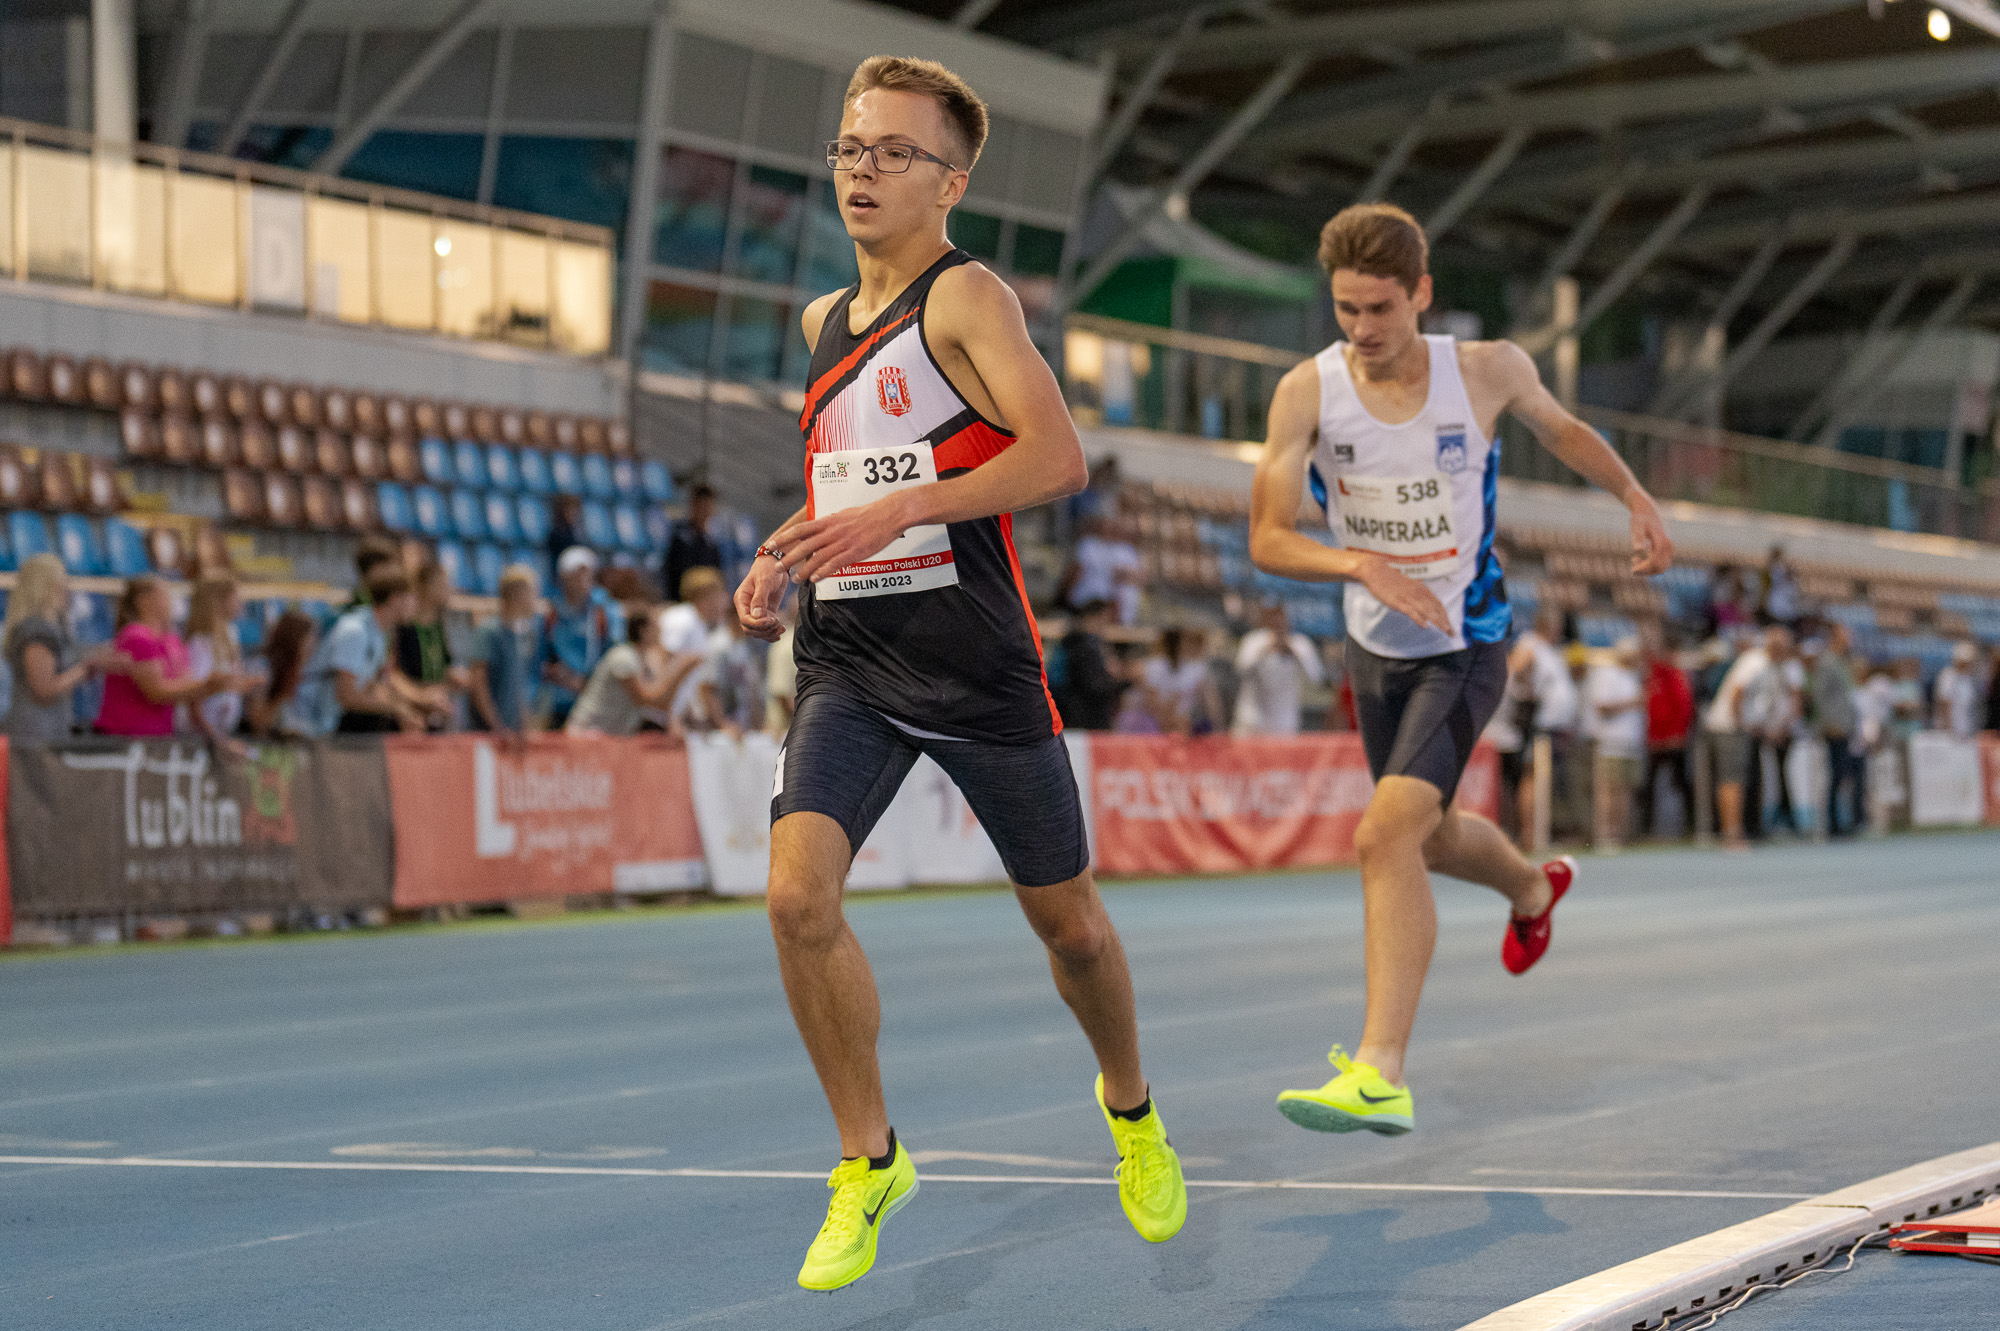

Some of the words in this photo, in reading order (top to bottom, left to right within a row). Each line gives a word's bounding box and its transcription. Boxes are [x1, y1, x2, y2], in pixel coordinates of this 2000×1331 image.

[863, 452, 921, 485] 332
[1396, 479, 1440, 504] 538
[1344, 513, 1452, 542] NAPIERAŁA
[842, 563, 893, 575] Mistrzostwa
[894, 558, 921, 570] Polski
[922, 555, 942, 566] U20
[838, 578, 879, 591] LUBLIN
[881, 575, 912, 588] 2023
